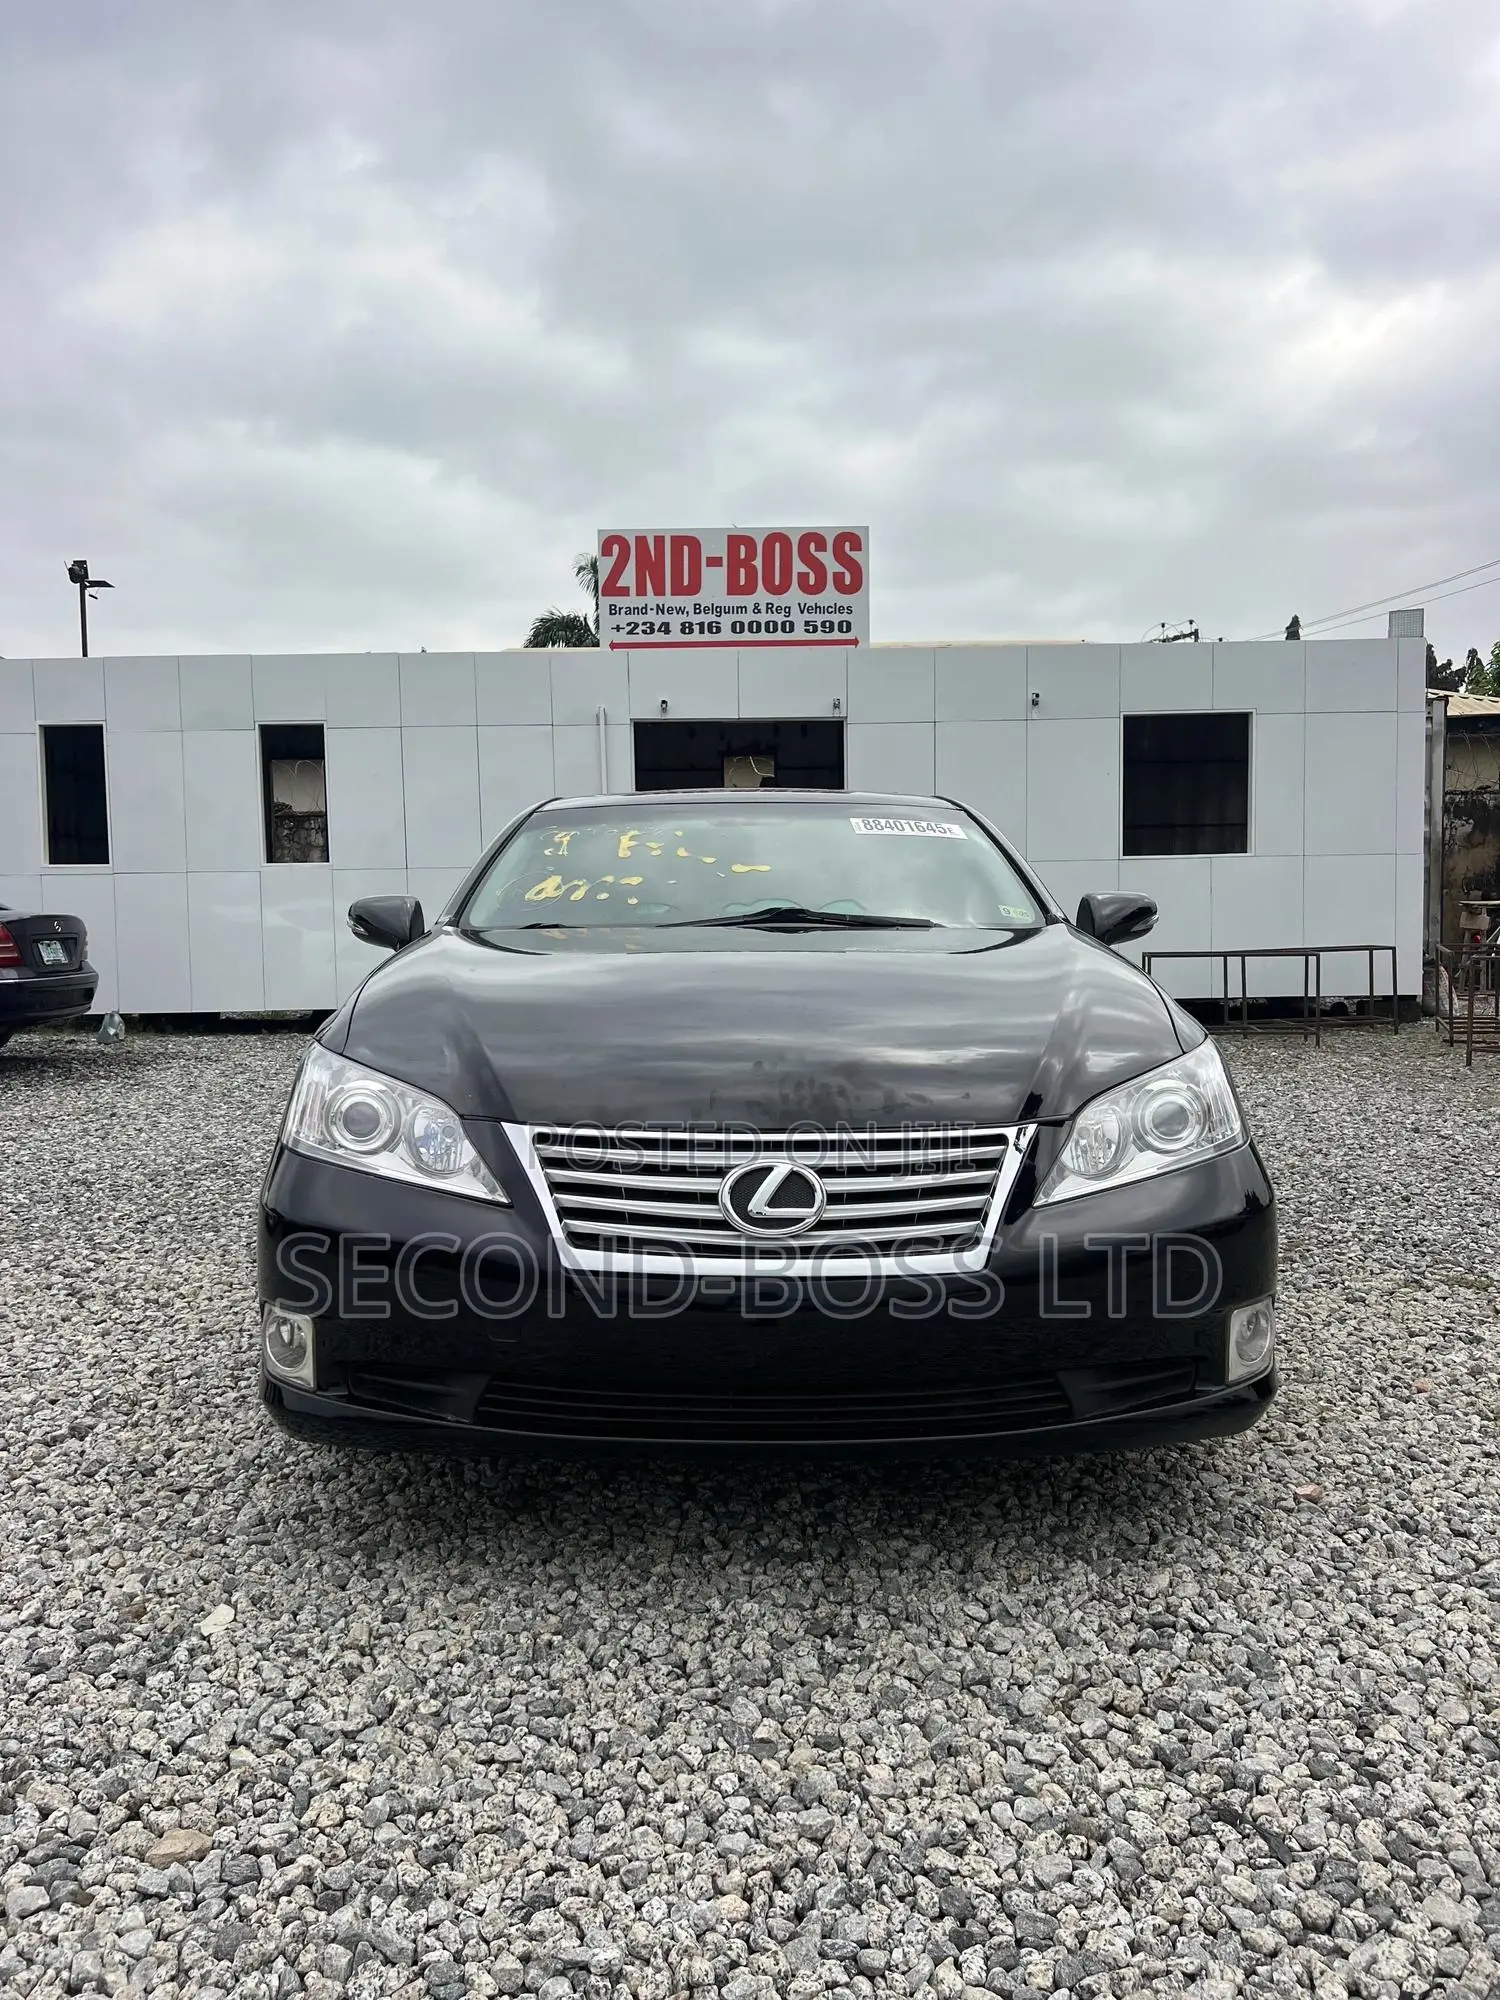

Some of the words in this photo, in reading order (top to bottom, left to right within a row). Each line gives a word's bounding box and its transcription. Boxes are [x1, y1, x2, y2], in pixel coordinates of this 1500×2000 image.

[600, 531, 864, 597] 2ND-BOSS
[608, 602, 690, 617] Brand-New,
[752, 602, 762, 614] &
[765, 602, 792, 617] Reg
[797, 602, 853, 615] Vehicles
[610, 620, 672, 635] +234
[679, 620, 722, 635] 816
[730, 619, 795, 634] 0000
[803, 619, 853, 634] 590
